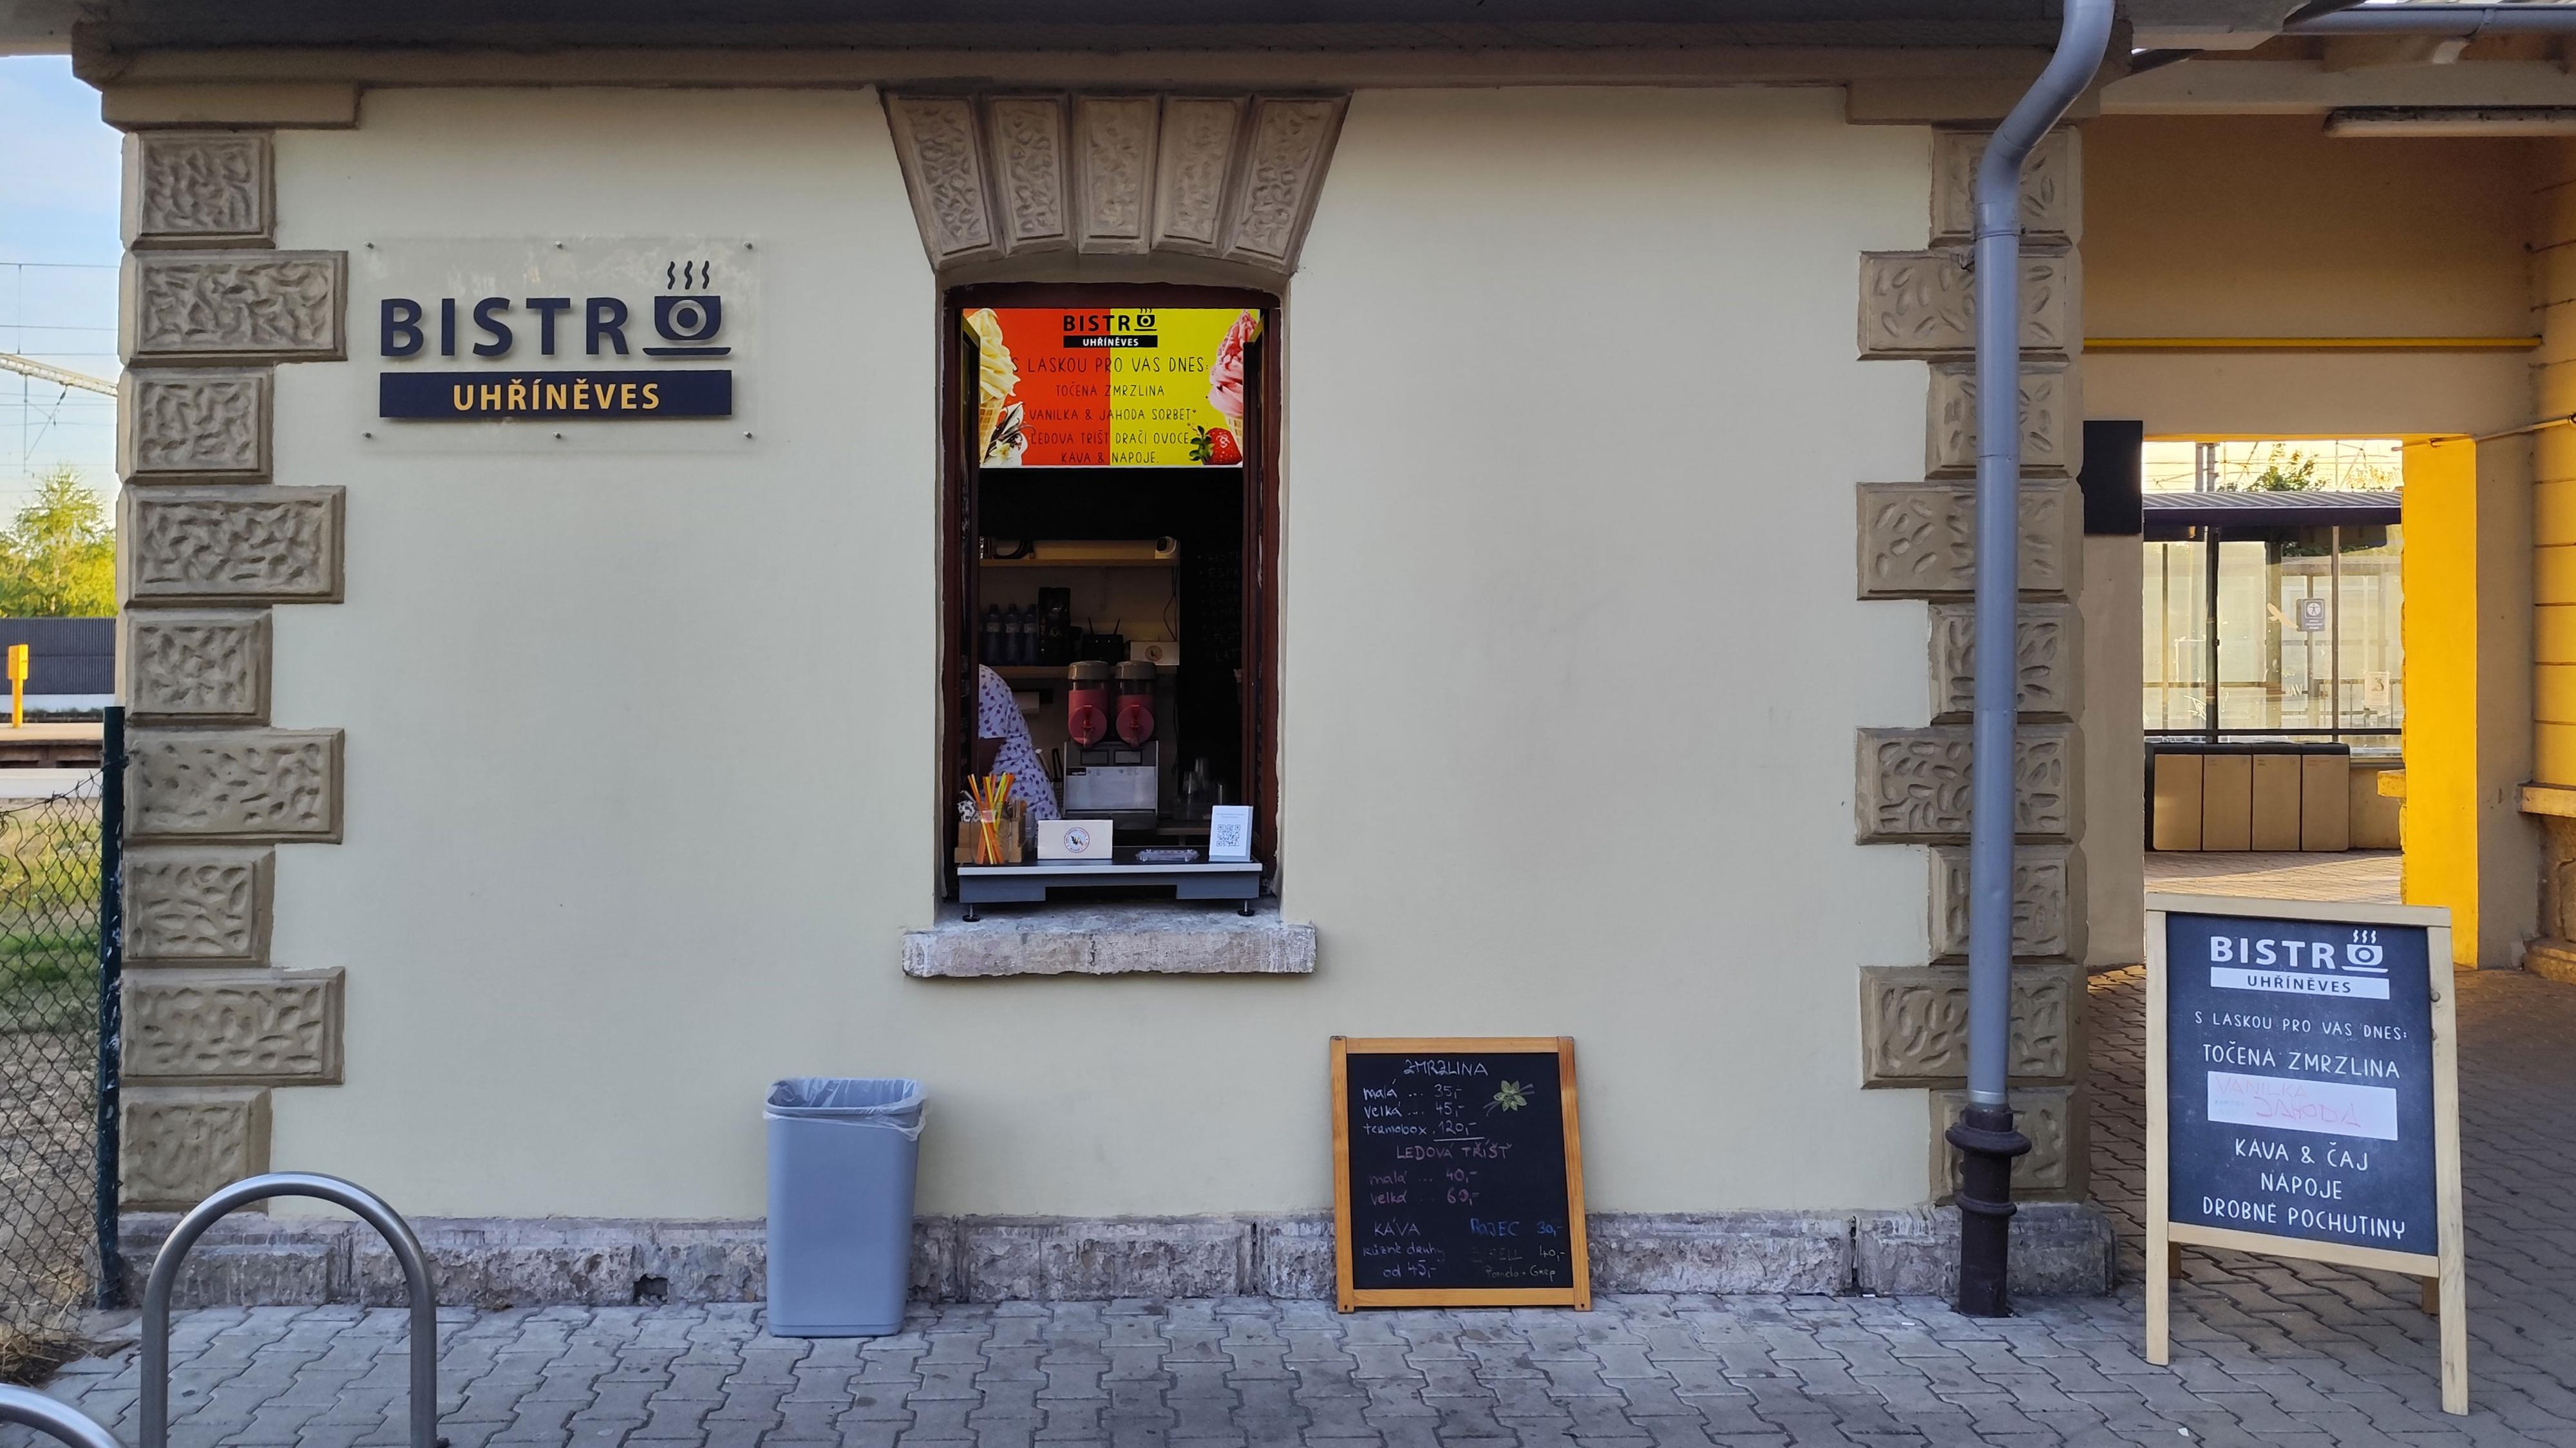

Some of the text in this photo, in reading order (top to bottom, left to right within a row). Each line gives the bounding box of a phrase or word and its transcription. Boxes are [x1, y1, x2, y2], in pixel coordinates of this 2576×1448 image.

[1083, 337, 1139, 346] UHŘÍNĚVES
[1095, 357, 1122, 373] PRO
[1170, 357, 1208, 372] DNES:
[453, 378, 661, 411] UHŘÍNĚVES
[1104, 384, 1164, 397] ZMRZLINA
[1029, 408, 1078, 421] VANILKA
[1085, 408, 1093, 420] &
[1099, 408, 1145, 421] JAHODA
[1097, 452, 1105, 463] &
[2247, 975, 2351, 993] UHŘÍNĚVES
[2195, 1011, 2202, 1024] S
[2282, 1018, 2311, 1032] PRO
[2363, 1024, 2407, 1040] DNES:
[2288, 1051, 2400, 1078] ZMRZLINA
[1363, 1078, 1397, 1100] malá
[2215, 1075, 2308, 1098] VANILKA
[2253, 1096, 2362, 1128] JAHODA
[1397, 1143, 1454, 1160] LEDOVÁ
[2301, 1145, 2315, 1164] &
[2327, 1141, 2368, 1171] ČAJ
[1374, 1218, 1421, 1237] KÁVA
[2288, 1207, 2405, 1241] POCHUTINY
[1383, 1264, 1401, 1277] od
